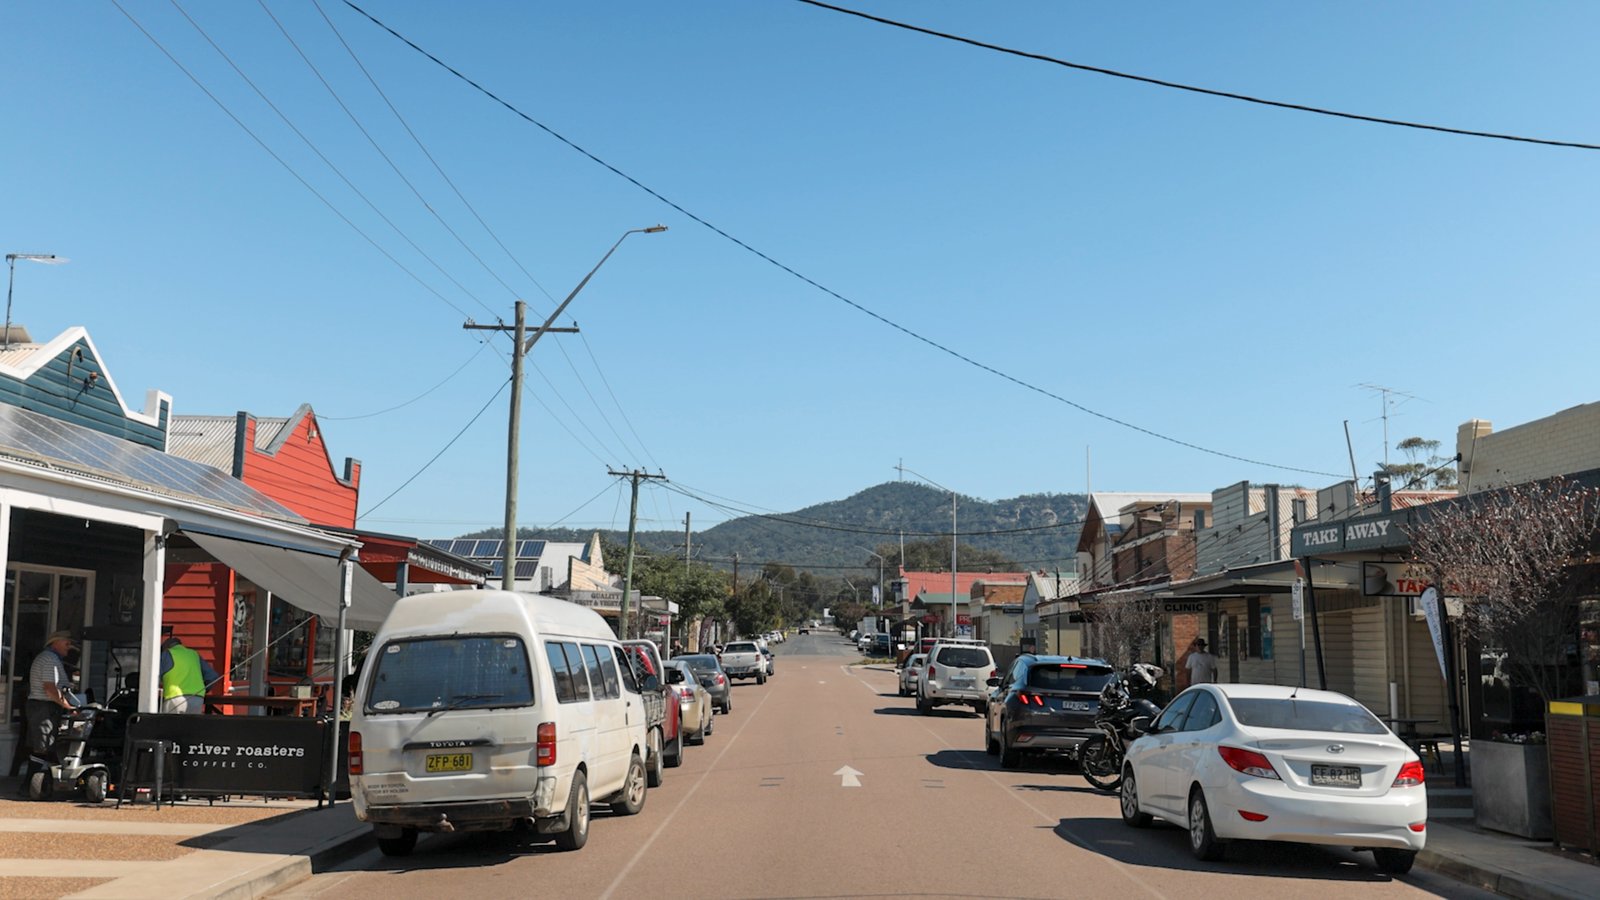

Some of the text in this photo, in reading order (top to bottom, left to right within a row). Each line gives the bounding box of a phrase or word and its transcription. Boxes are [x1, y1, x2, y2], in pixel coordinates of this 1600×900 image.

[1303, 520, 1390, 546] TAKE AWAY
[1164, 603, 1204, 612] CLINIC
[187, 743, 231, 755] river
[236, 744, 305, 757] roasters
[182, 760, 236, 768] COFFEE
